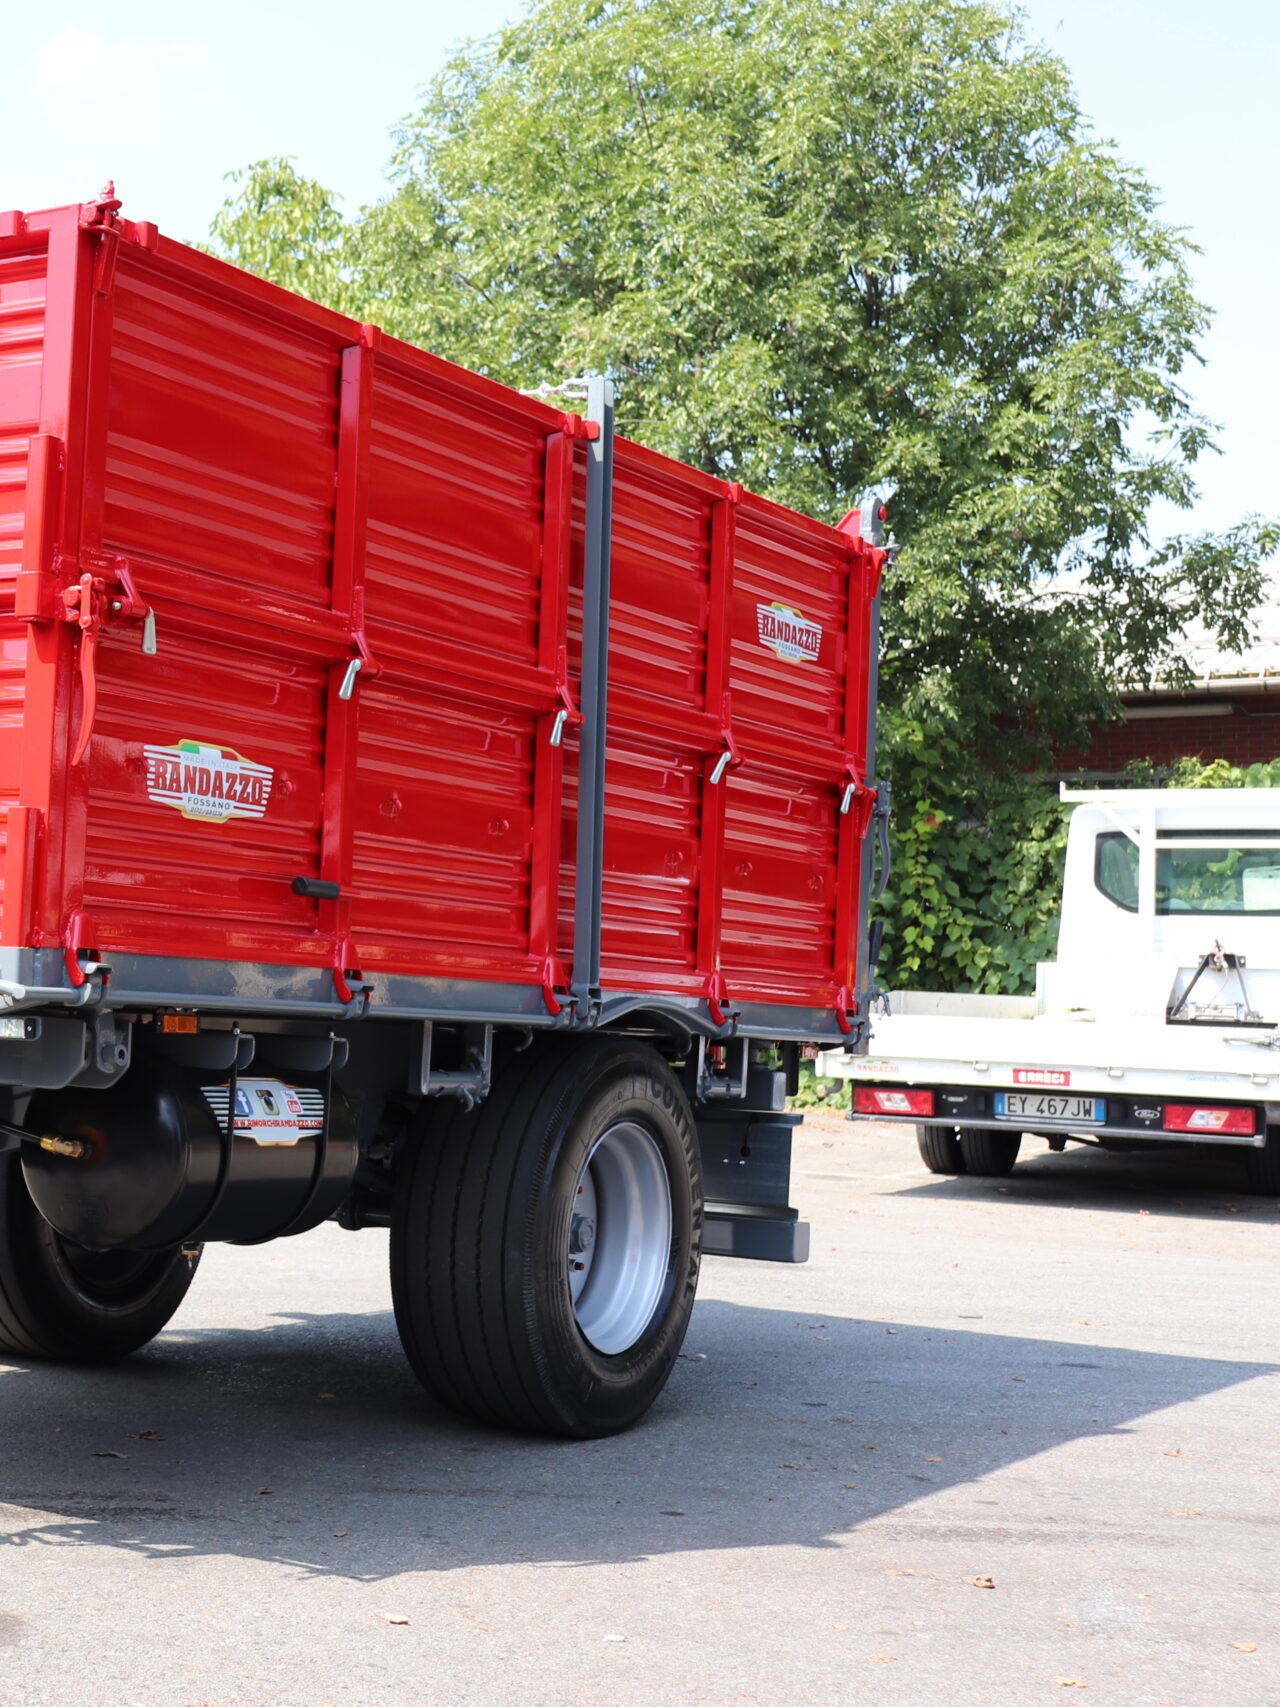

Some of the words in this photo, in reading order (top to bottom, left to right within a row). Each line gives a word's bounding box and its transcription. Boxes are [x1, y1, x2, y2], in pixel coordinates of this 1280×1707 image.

[762, 615, 817, 652] RANDAZZO
[153, 759, 264, 805] RANDAZZO
[187, 796, 230, 810] FOSSANO
[1006, 1096, 1028, 1114] EY
[225, 1118, 325, 1128] WW.RIMORCHIRANDAZZO.COM
